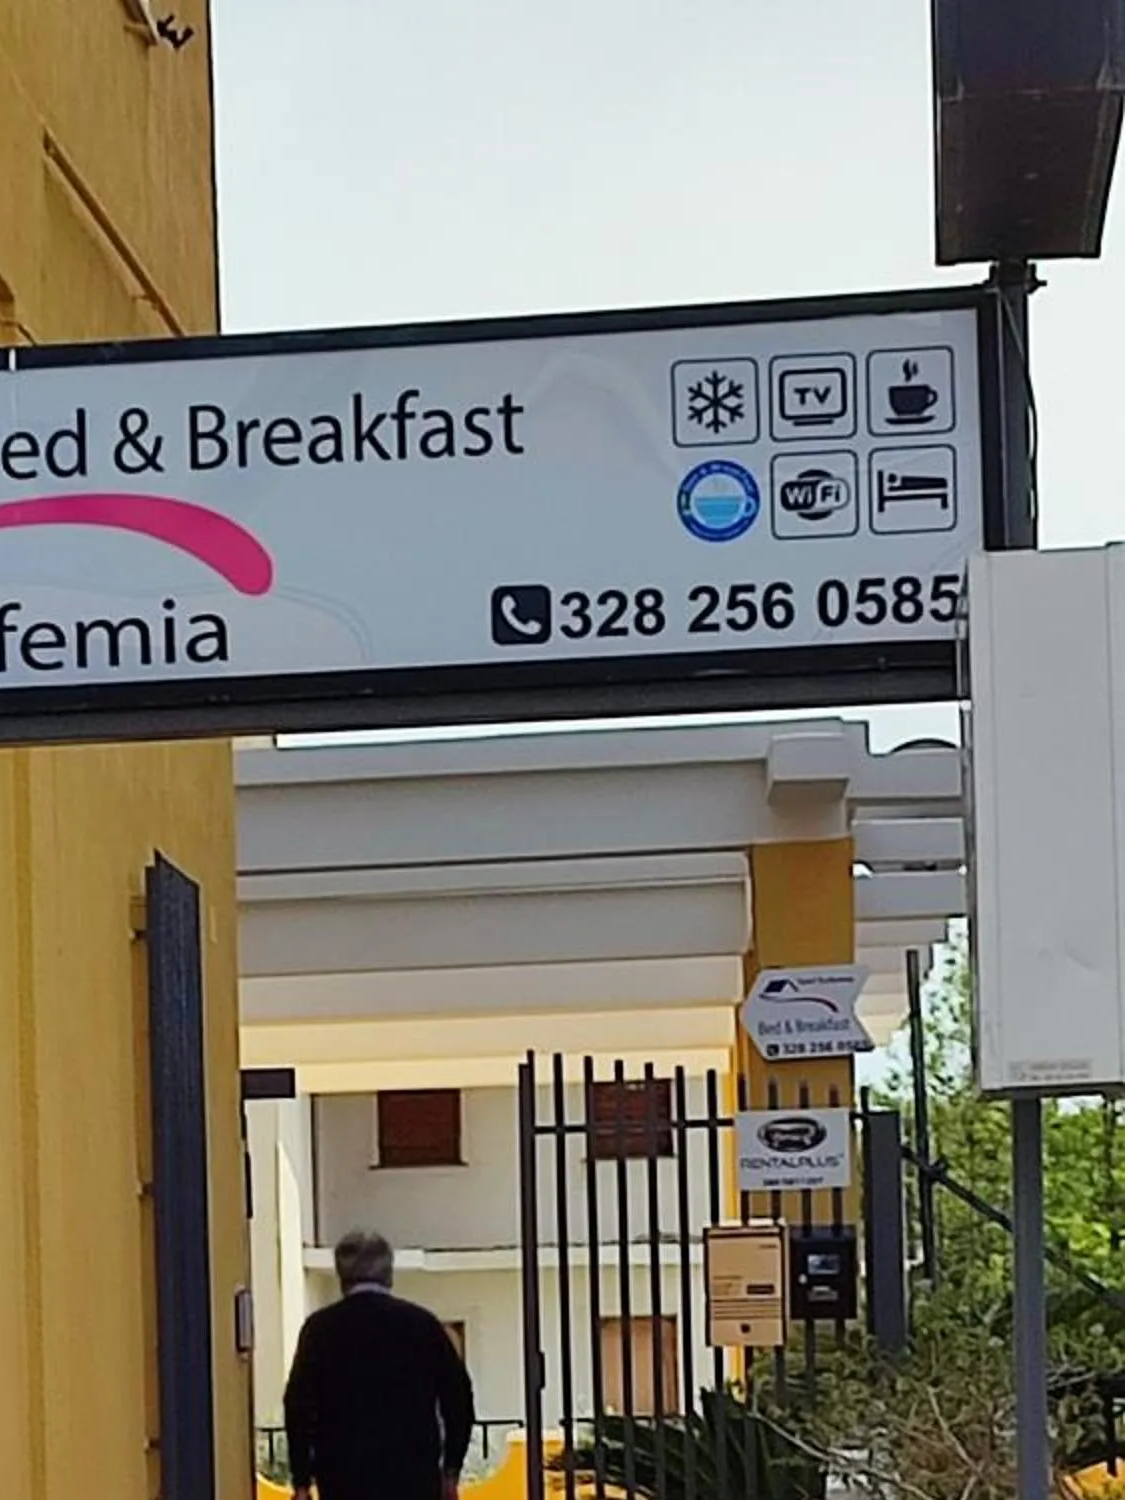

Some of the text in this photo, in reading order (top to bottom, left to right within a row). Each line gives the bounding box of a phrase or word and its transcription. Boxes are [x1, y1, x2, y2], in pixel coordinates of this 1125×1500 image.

[793, 386, 832, 406] TV
[113, 407, 166, 475] &
[188, 389, 525, 471] Breakfast
[560, 574, 961, 639] 328 256 0585
